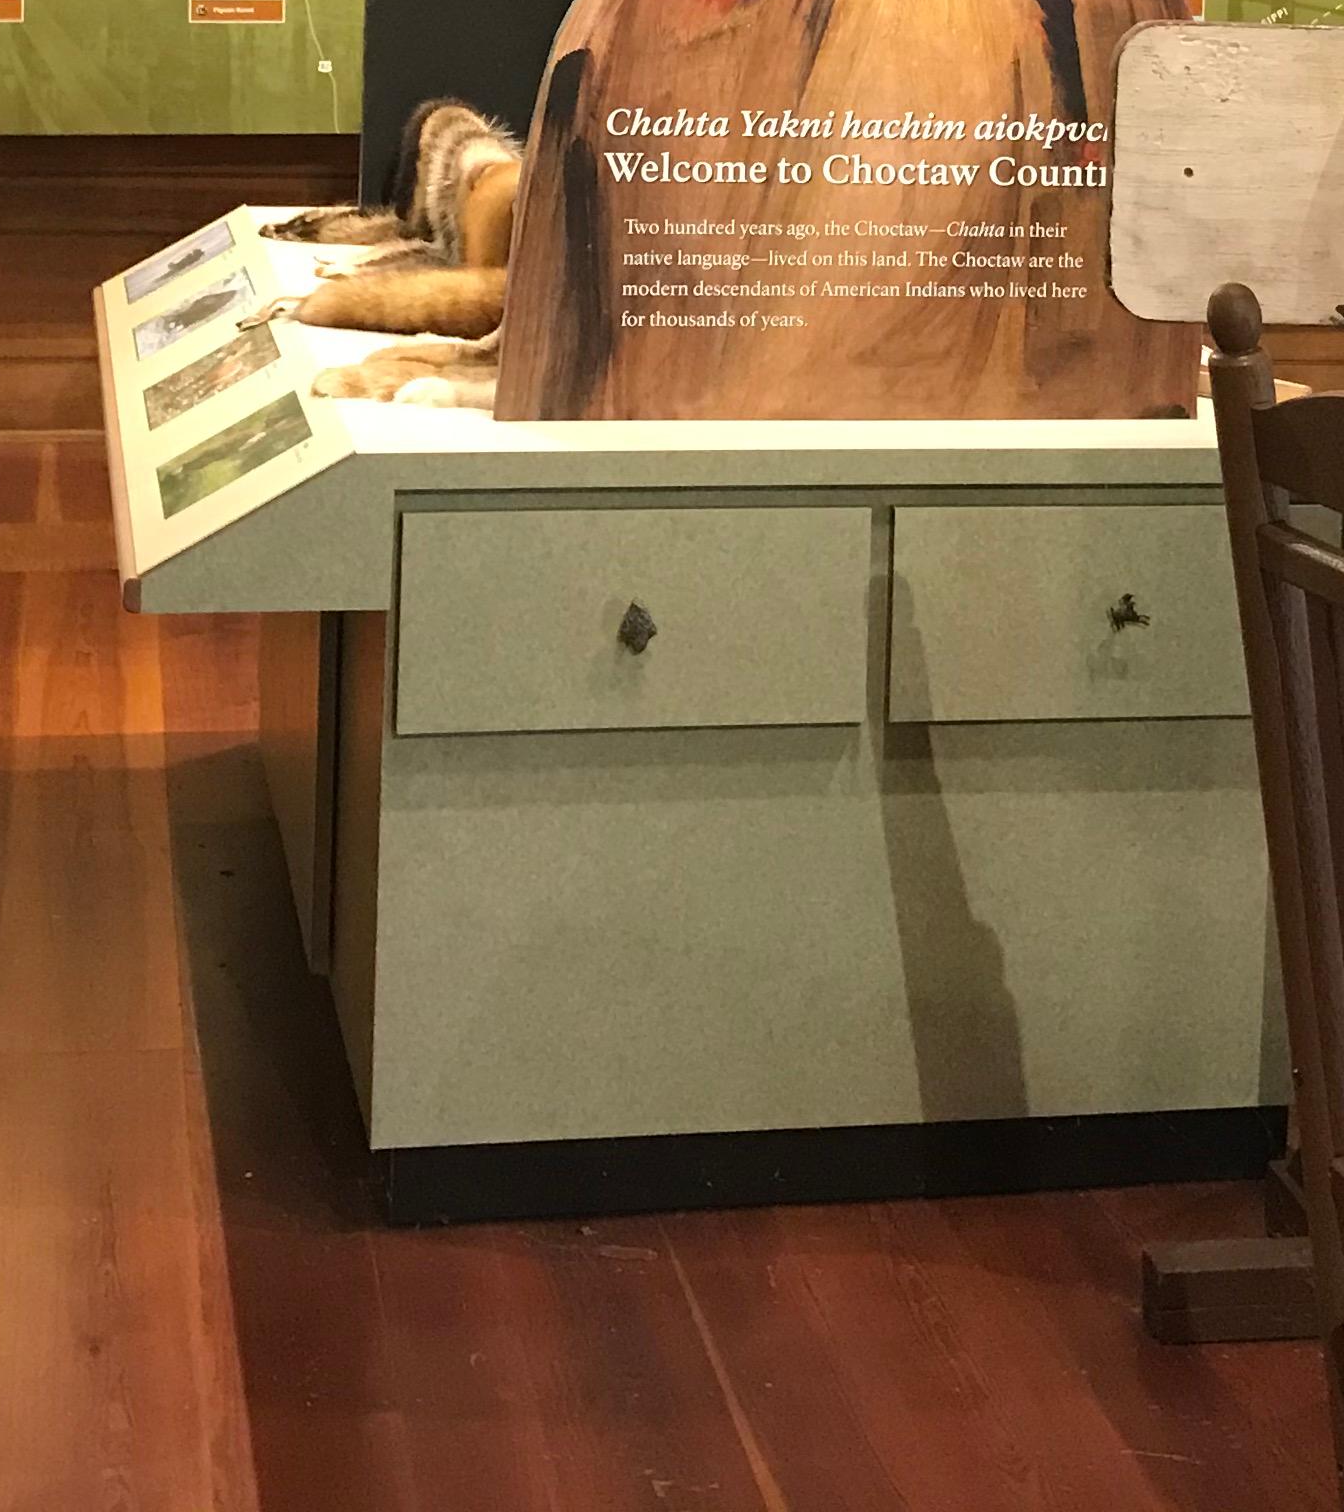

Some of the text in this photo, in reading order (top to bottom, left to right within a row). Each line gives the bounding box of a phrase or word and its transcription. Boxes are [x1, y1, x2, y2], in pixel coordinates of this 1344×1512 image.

[605, 107, 1108, 149] Chahta Yakni hachim aiokpvc
[604, 151, 767, 183] Welcome
[778, 157, 812, 184] to
[822, 155, 980, 186] Choctaw
[624, 218, 660, 235] Two
[663, 218, 735, 236] hundred
[739, 223, 783, 239] years
[786, 224, 821, 239] ago,
[824, 220, 850, 236] the
[1008, 221, 1026, 237] in
[1029, 221, 1068, 238] their
[623, 249, 673, 267] native
[812, 255, 833, 267] on
[837, 250, 868, 267] this
[871, 251, 912, 267] land.
[915, 251, 948, 268] The
[951, 251, 1025, 269] Choctaw
[1028, 256, 1054, 269] are
[1058, 252, 1084, 269] the
[622, 280, 1087, 299] modern descendants of American Indians who lived here
[621, 310, 809, 331] for thousands of years.
